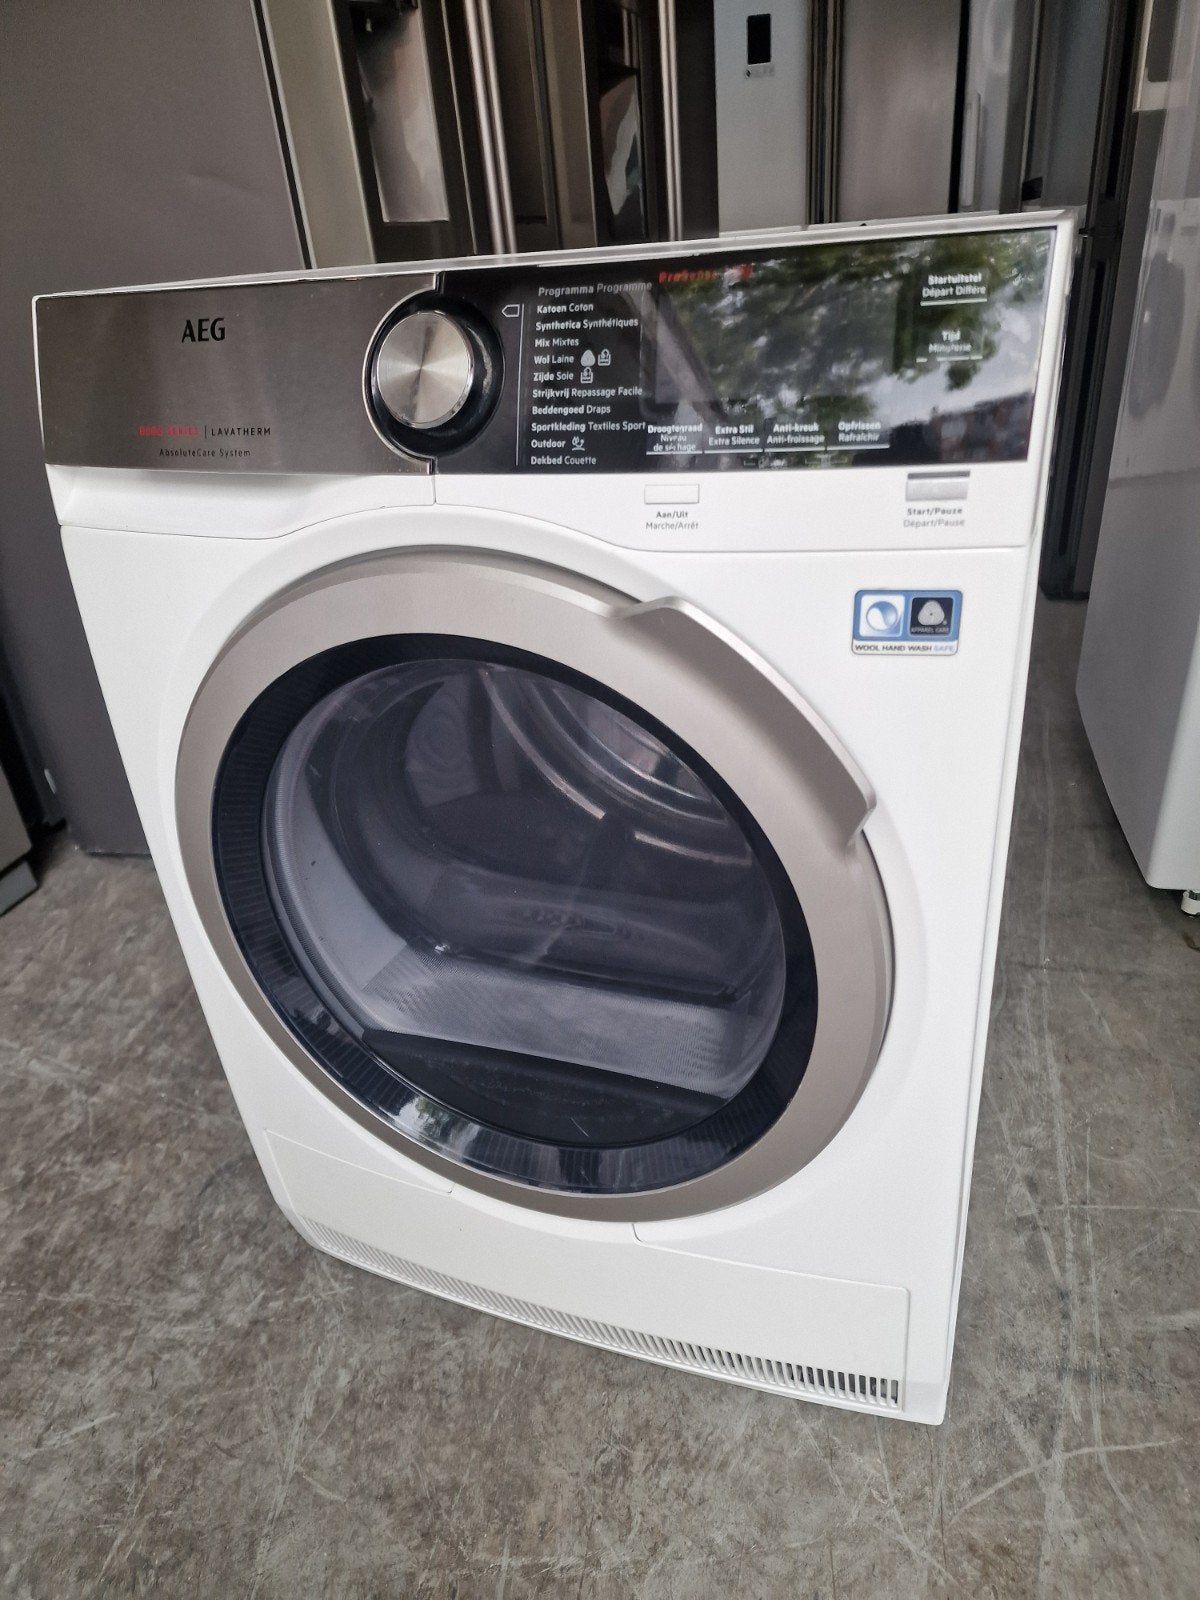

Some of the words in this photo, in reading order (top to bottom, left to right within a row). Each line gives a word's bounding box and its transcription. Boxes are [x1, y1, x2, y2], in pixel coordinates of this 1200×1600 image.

[538, 286, 594, 297] Programma
[597, 282, 652, 294] Programme
[537, 305, 567, 314] Katoen
[569, 303, 594, 312] Coton
[181, 318, 225, 342] AEG
[536, 320, 580, 332] Synthetica
[583, 318, 639, 329] Synthétiques
[535, 339, 550, 347] Mix
[552, 338, 579, 346] Mixtes
[534, 355, 550, 364] Wol
[552, 355, 574, 363] Laine
[533, 372, 555, 383] Zijde
[556, 371, 574, 380] Soie
[532, 388, 570, 399] Strijkvrij
[571, 388, 616, 398] Repassage
[618, 386, 643, 396] Facile
[532, 405, 584, 416] Beddengoed
[586, 405, 611, 415] Draps
[211, 427, 271, 436] LAVATHERM
[531, 422, 586, 433] Sportkleding
[588, 421, 620, 431] Textiles
[622, 421, 646, 432] Sport
[648, 423, 703, 434] Droogtegraad
[715, 425, 738, 434] Extra
[739, 424, 754, 434] Stil
[773, 421, 820, 432] Anti-kreuk
[530, 439, 566, 448] Outdoor
[708, 437, 730, 446] Extra
[731, 436, 760, 445] Silence
[766, 435, 825, 445] Anti-froissage
[653, 444, 663, 452] de
[159, 448, 216, 457] AbsoluteCare
[219, 448, 250, 459] System
[530, 456, 562, 465] Dekbed
[564, 456, 597, 465] Couette
[656, 510, 688, 518] Aan/Uit
[645, 521, 699, 530] Marche/Arrêt
[903, 519, 965, 529] Départ/Pause
[882, 644, 906, 652] HAND
